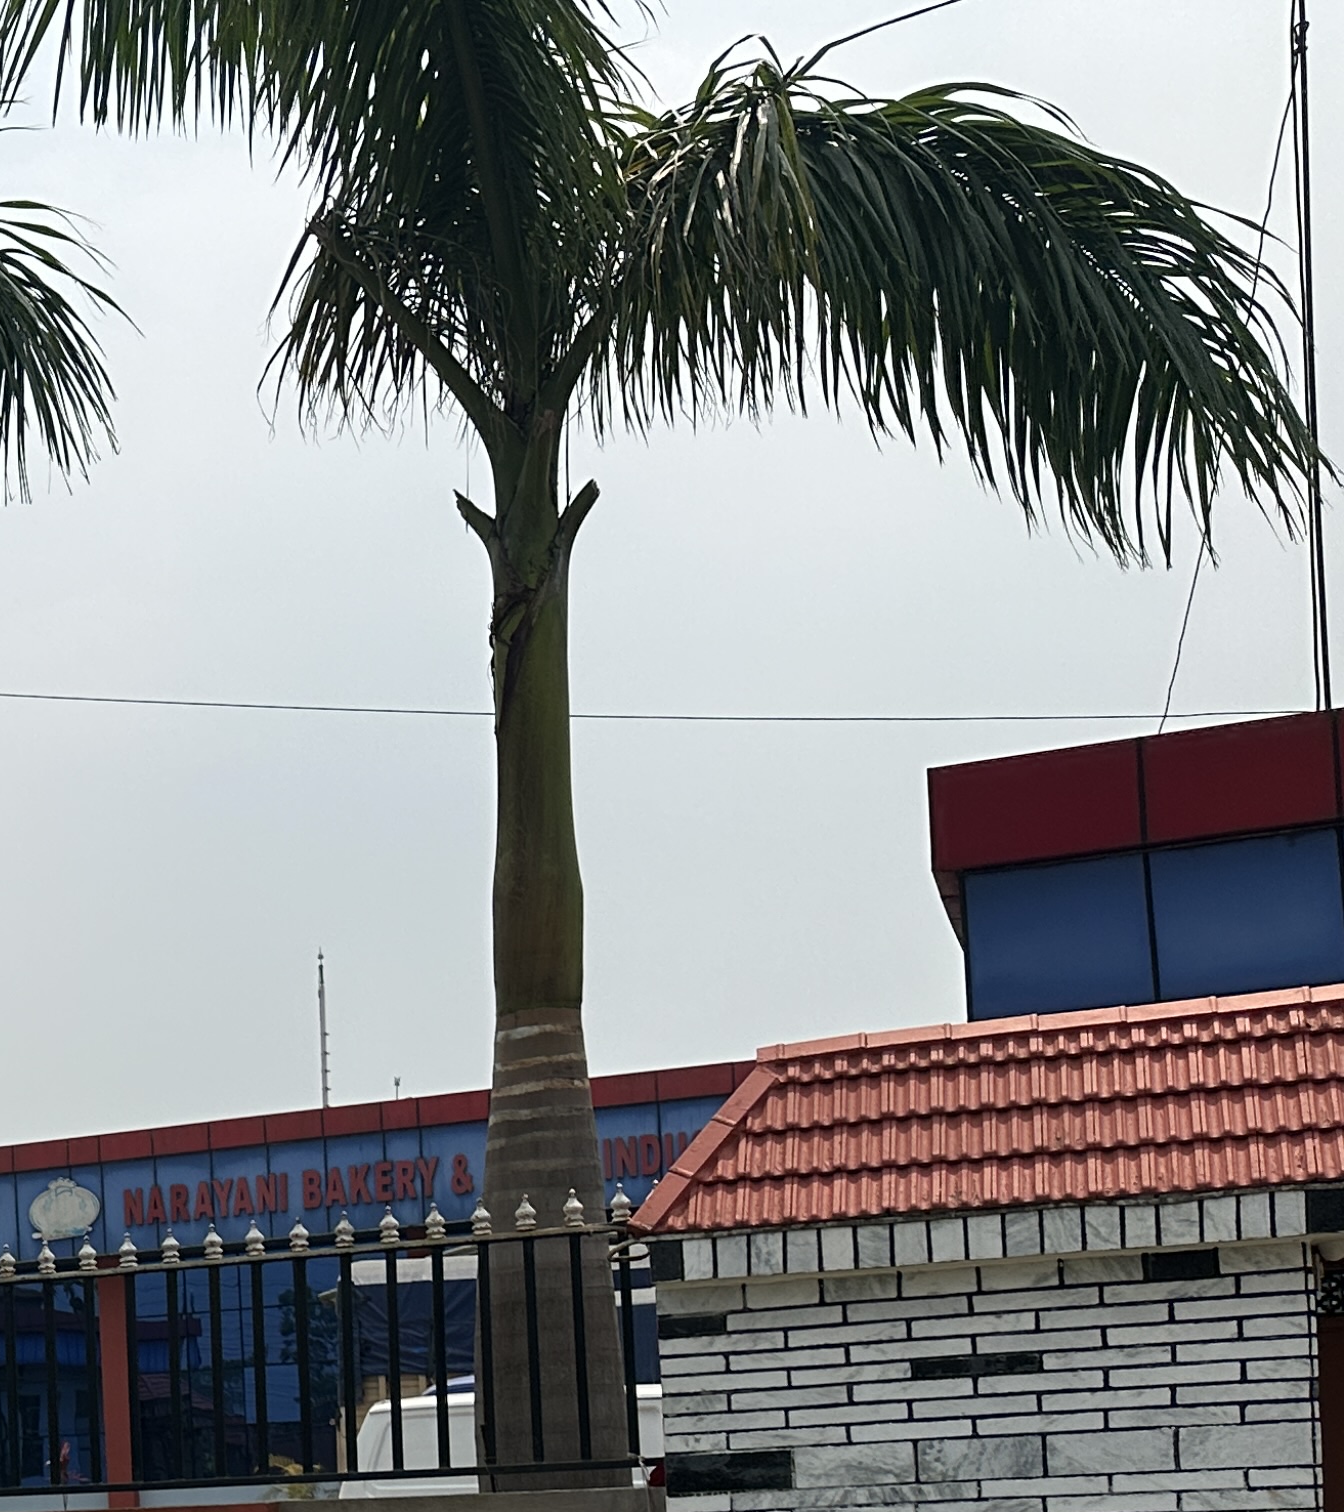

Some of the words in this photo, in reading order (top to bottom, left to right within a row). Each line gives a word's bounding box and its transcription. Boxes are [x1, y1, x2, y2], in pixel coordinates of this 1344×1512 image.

[123, 1172, 288, 1227] NARAYANI
[302, 1156, 439, 1209] BAKERY
[450, 1153, 475, 1196] &
